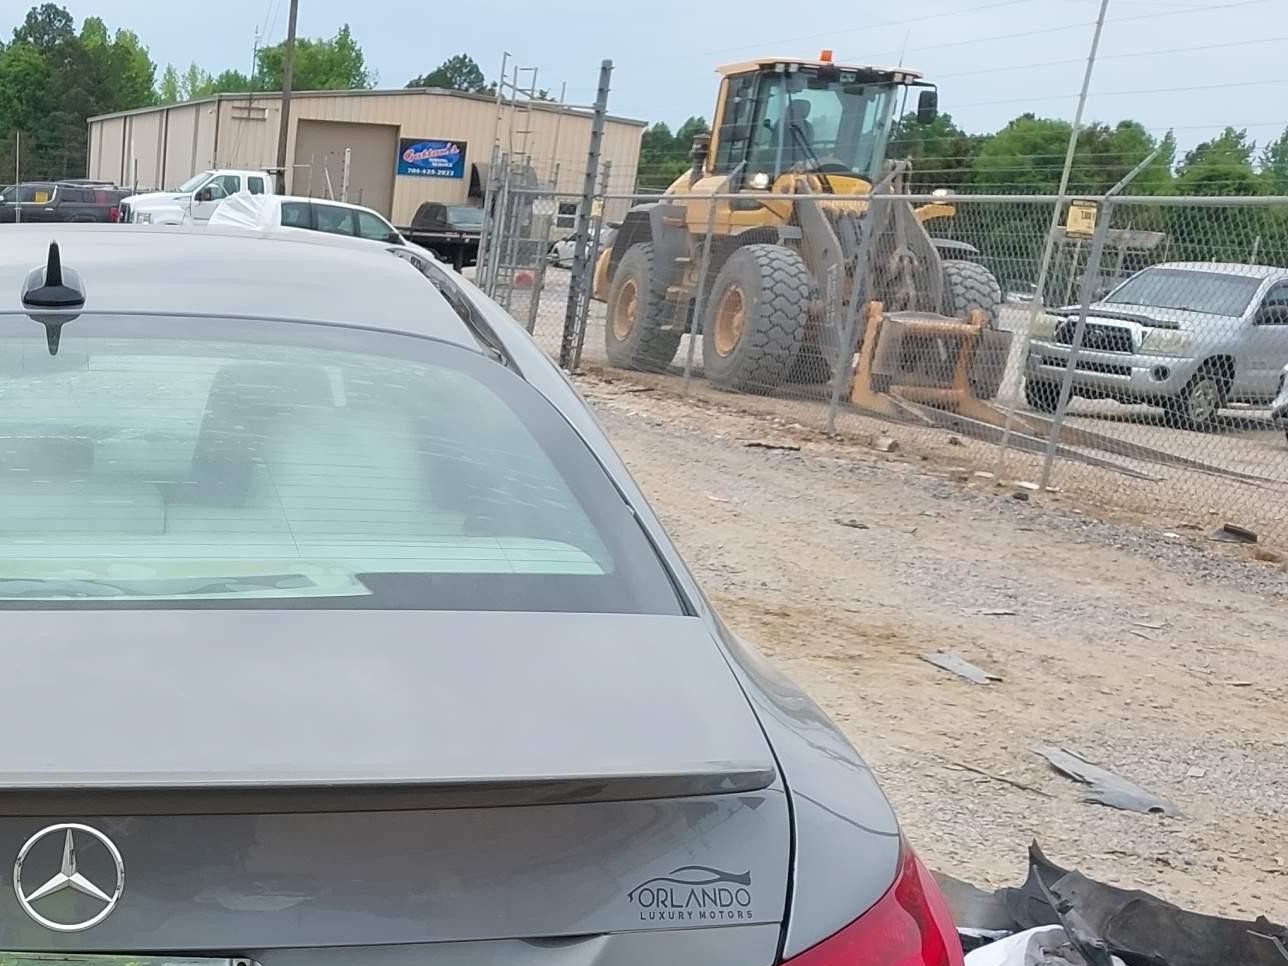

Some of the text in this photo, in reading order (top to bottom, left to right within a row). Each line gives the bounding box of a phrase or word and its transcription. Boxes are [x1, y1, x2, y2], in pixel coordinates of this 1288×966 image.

[639, 888, 751, 908] ORLANDO
[640, 910, 753, 920] LUXURY MOTORS
